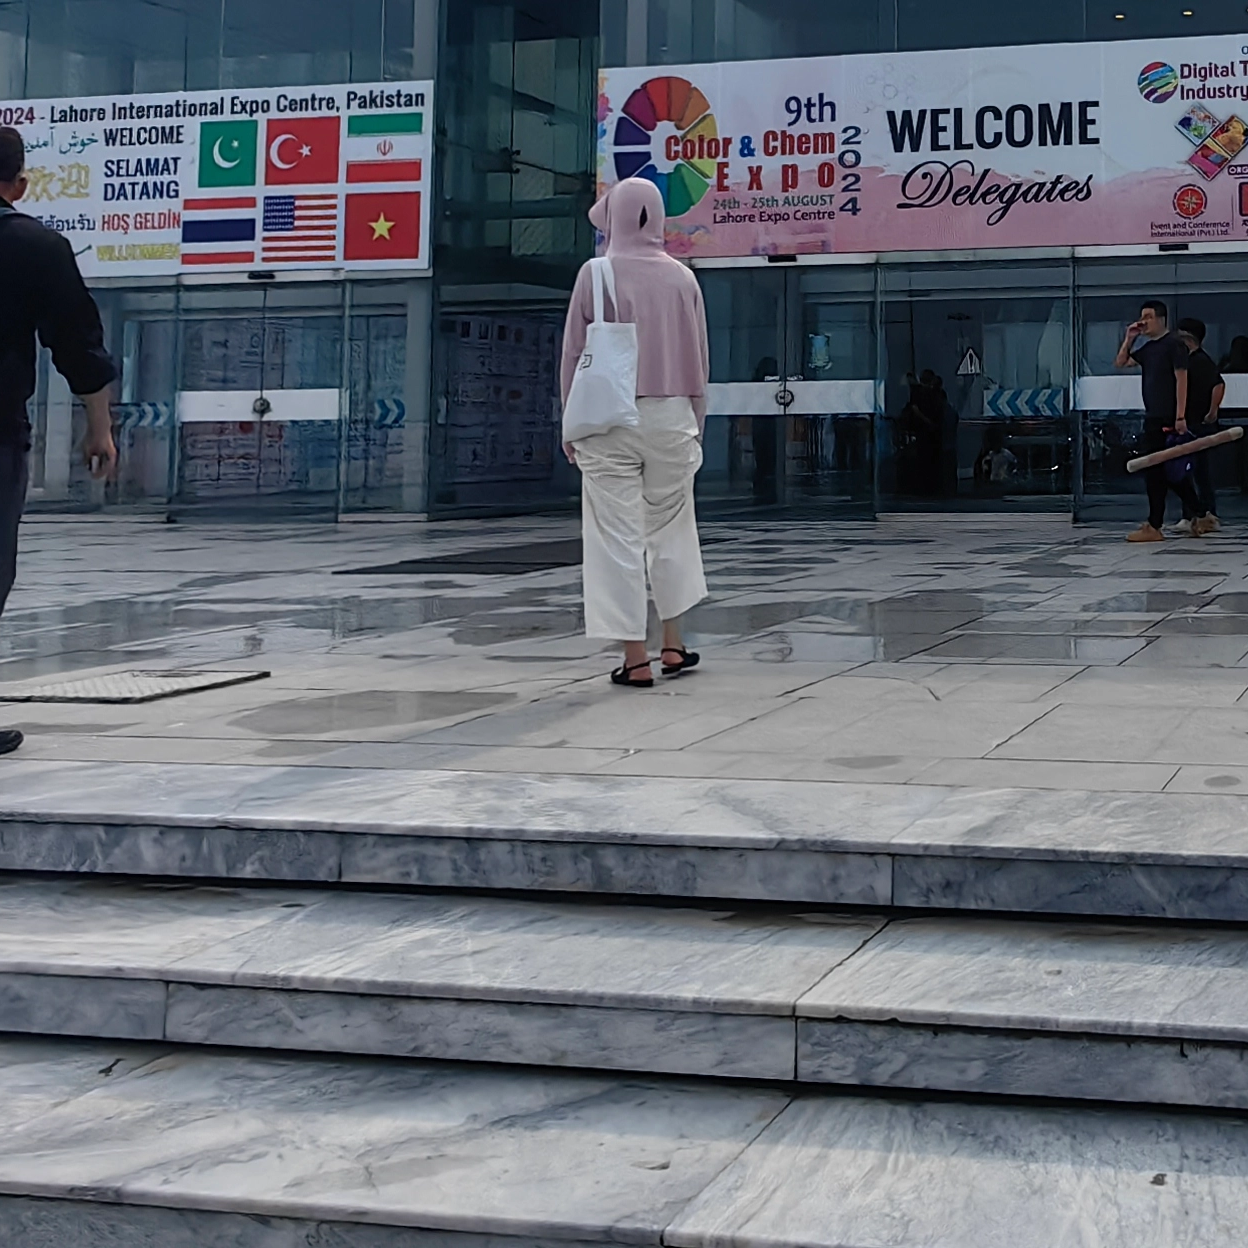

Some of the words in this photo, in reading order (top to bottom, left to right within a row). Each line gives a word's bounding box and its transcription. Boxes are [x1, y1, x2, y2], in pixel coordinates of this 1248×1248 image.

[1179, 61, 1237, 82] Digital
[50, 104, 106, 124] Lahore
[111, 96, 225, 120] International
[230, 95, 272, 117] Expo
[276, 93, 341, 113] Centre,
[346, 90, 426, 110] Pakistan
[785, 93, 836, 126] 9th
[103, 125, 184, 147] WELCOME
[886, 100, 1101, 153] WELCOME
[665, 134, 733, 162] Color
[739, 135, 756, 157] &
[763, 130, 836, 157] Chem
[104, 157, 181, 178] SELAMAT
[716, 161, 836, 193] Expo
[837, 126, 863, 216] 2024
[103, 180, 180, 202] DATANG
[713, 197, 740, 210] 24th
[751, 195, 779, 209] 25th
[782, 194, 835, 208] AUGUST
[896, 159, 1094, 227] Delegates
[101, 213, 131, 235] HOŞ
[713, 211, 756, 224] Lahore
[759, 210, 790, 225] Expo
[793, 208, 836, 222] Centre
